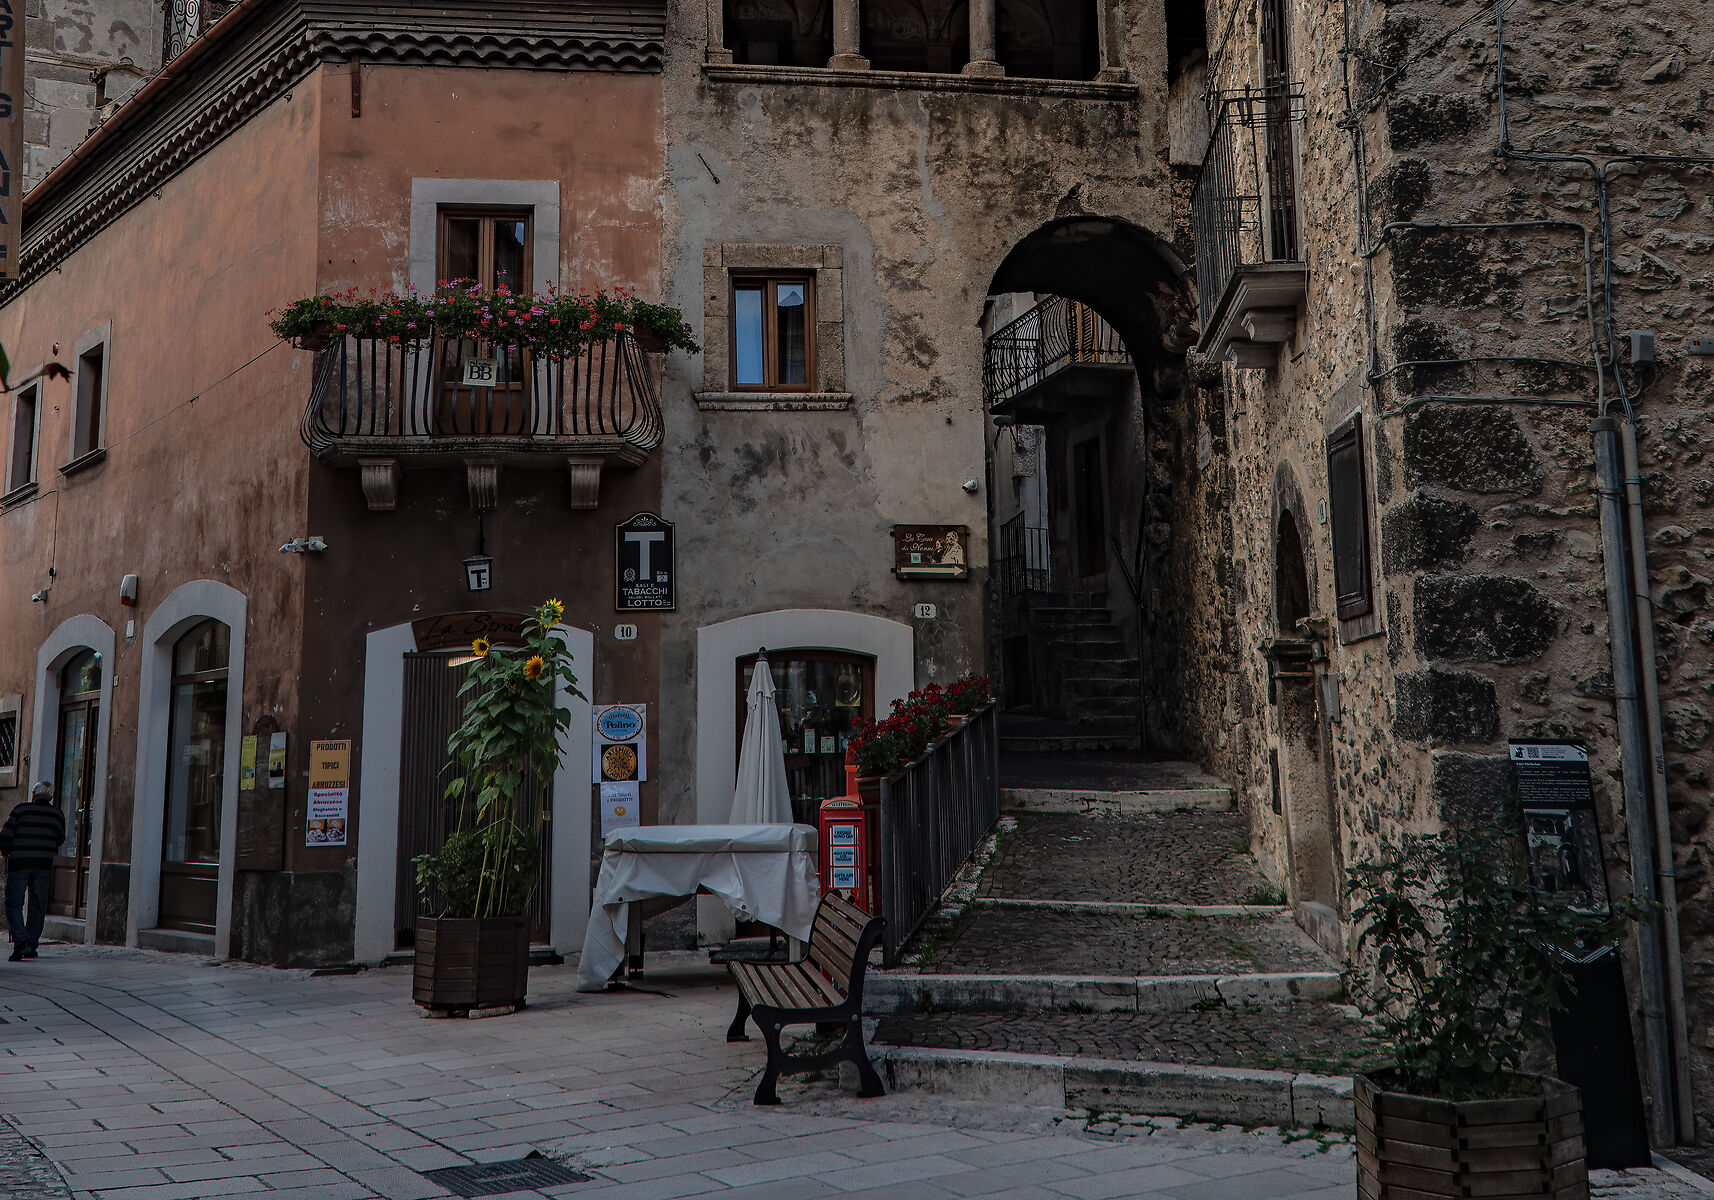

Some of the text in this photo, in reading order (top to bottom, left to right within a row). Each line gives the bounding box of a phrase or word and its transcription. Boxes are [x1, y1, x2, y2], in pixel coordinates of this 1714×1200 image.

[624, 531, 665, 581] T
[471, 568, 487, 588] T
[622, 587, 668, 596] TABACCHI
[628, 599, 663, 607] LOTTO
[920, 605, 931, 617] 12
[420, 614, 454, 642] La
[620, 626, 632, 638] 10
[316, 742, 347, 751] PRODOTTI
[322, 761, 340, 770] TIPICI
[311, 780, 346, 789] ABRUZZESI
